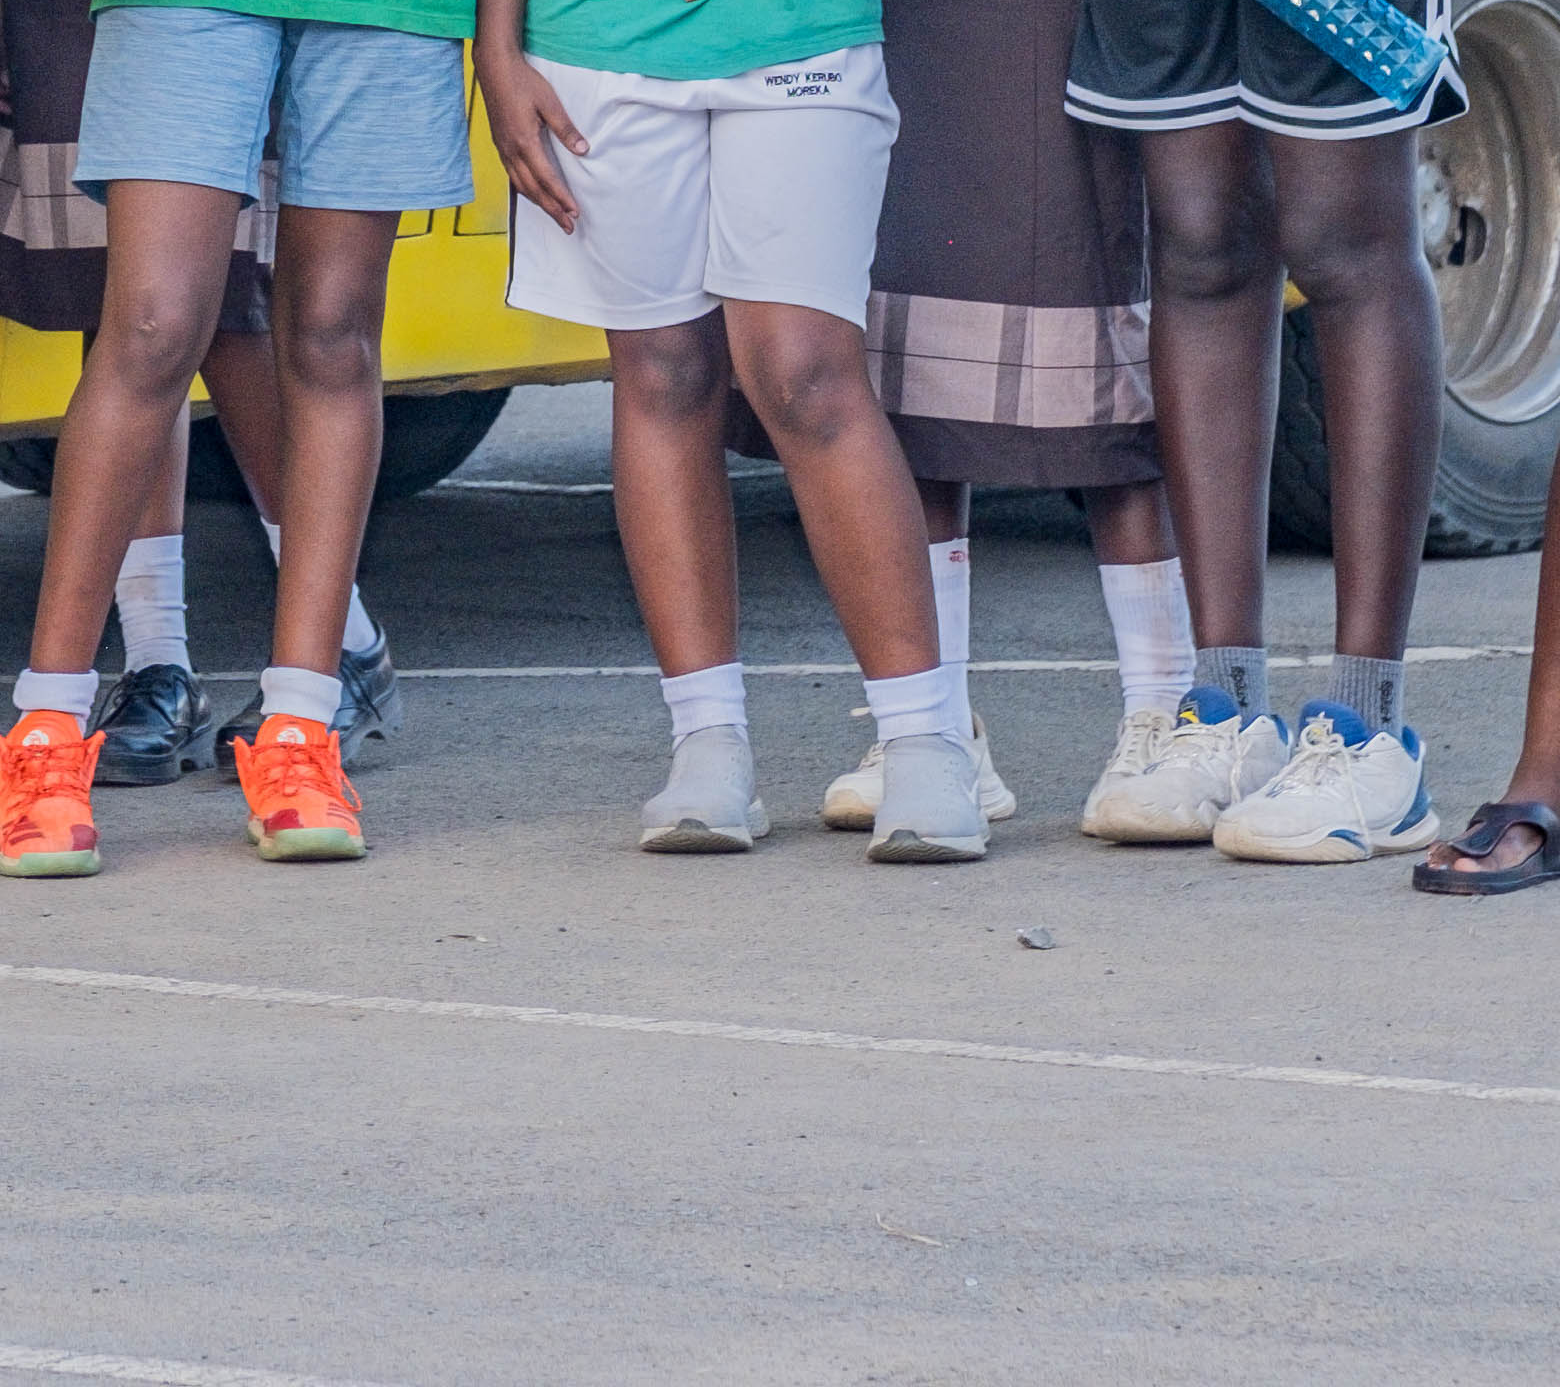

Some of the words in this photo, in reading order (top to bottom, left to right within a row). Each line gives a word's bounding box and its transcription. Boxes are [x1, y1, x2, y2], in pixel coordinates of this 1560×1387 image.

[764, 73, 800, 87] WENDY
[805, 72, 842, 83] KERUBO
[786, 85, 830, 97] MOREKA
